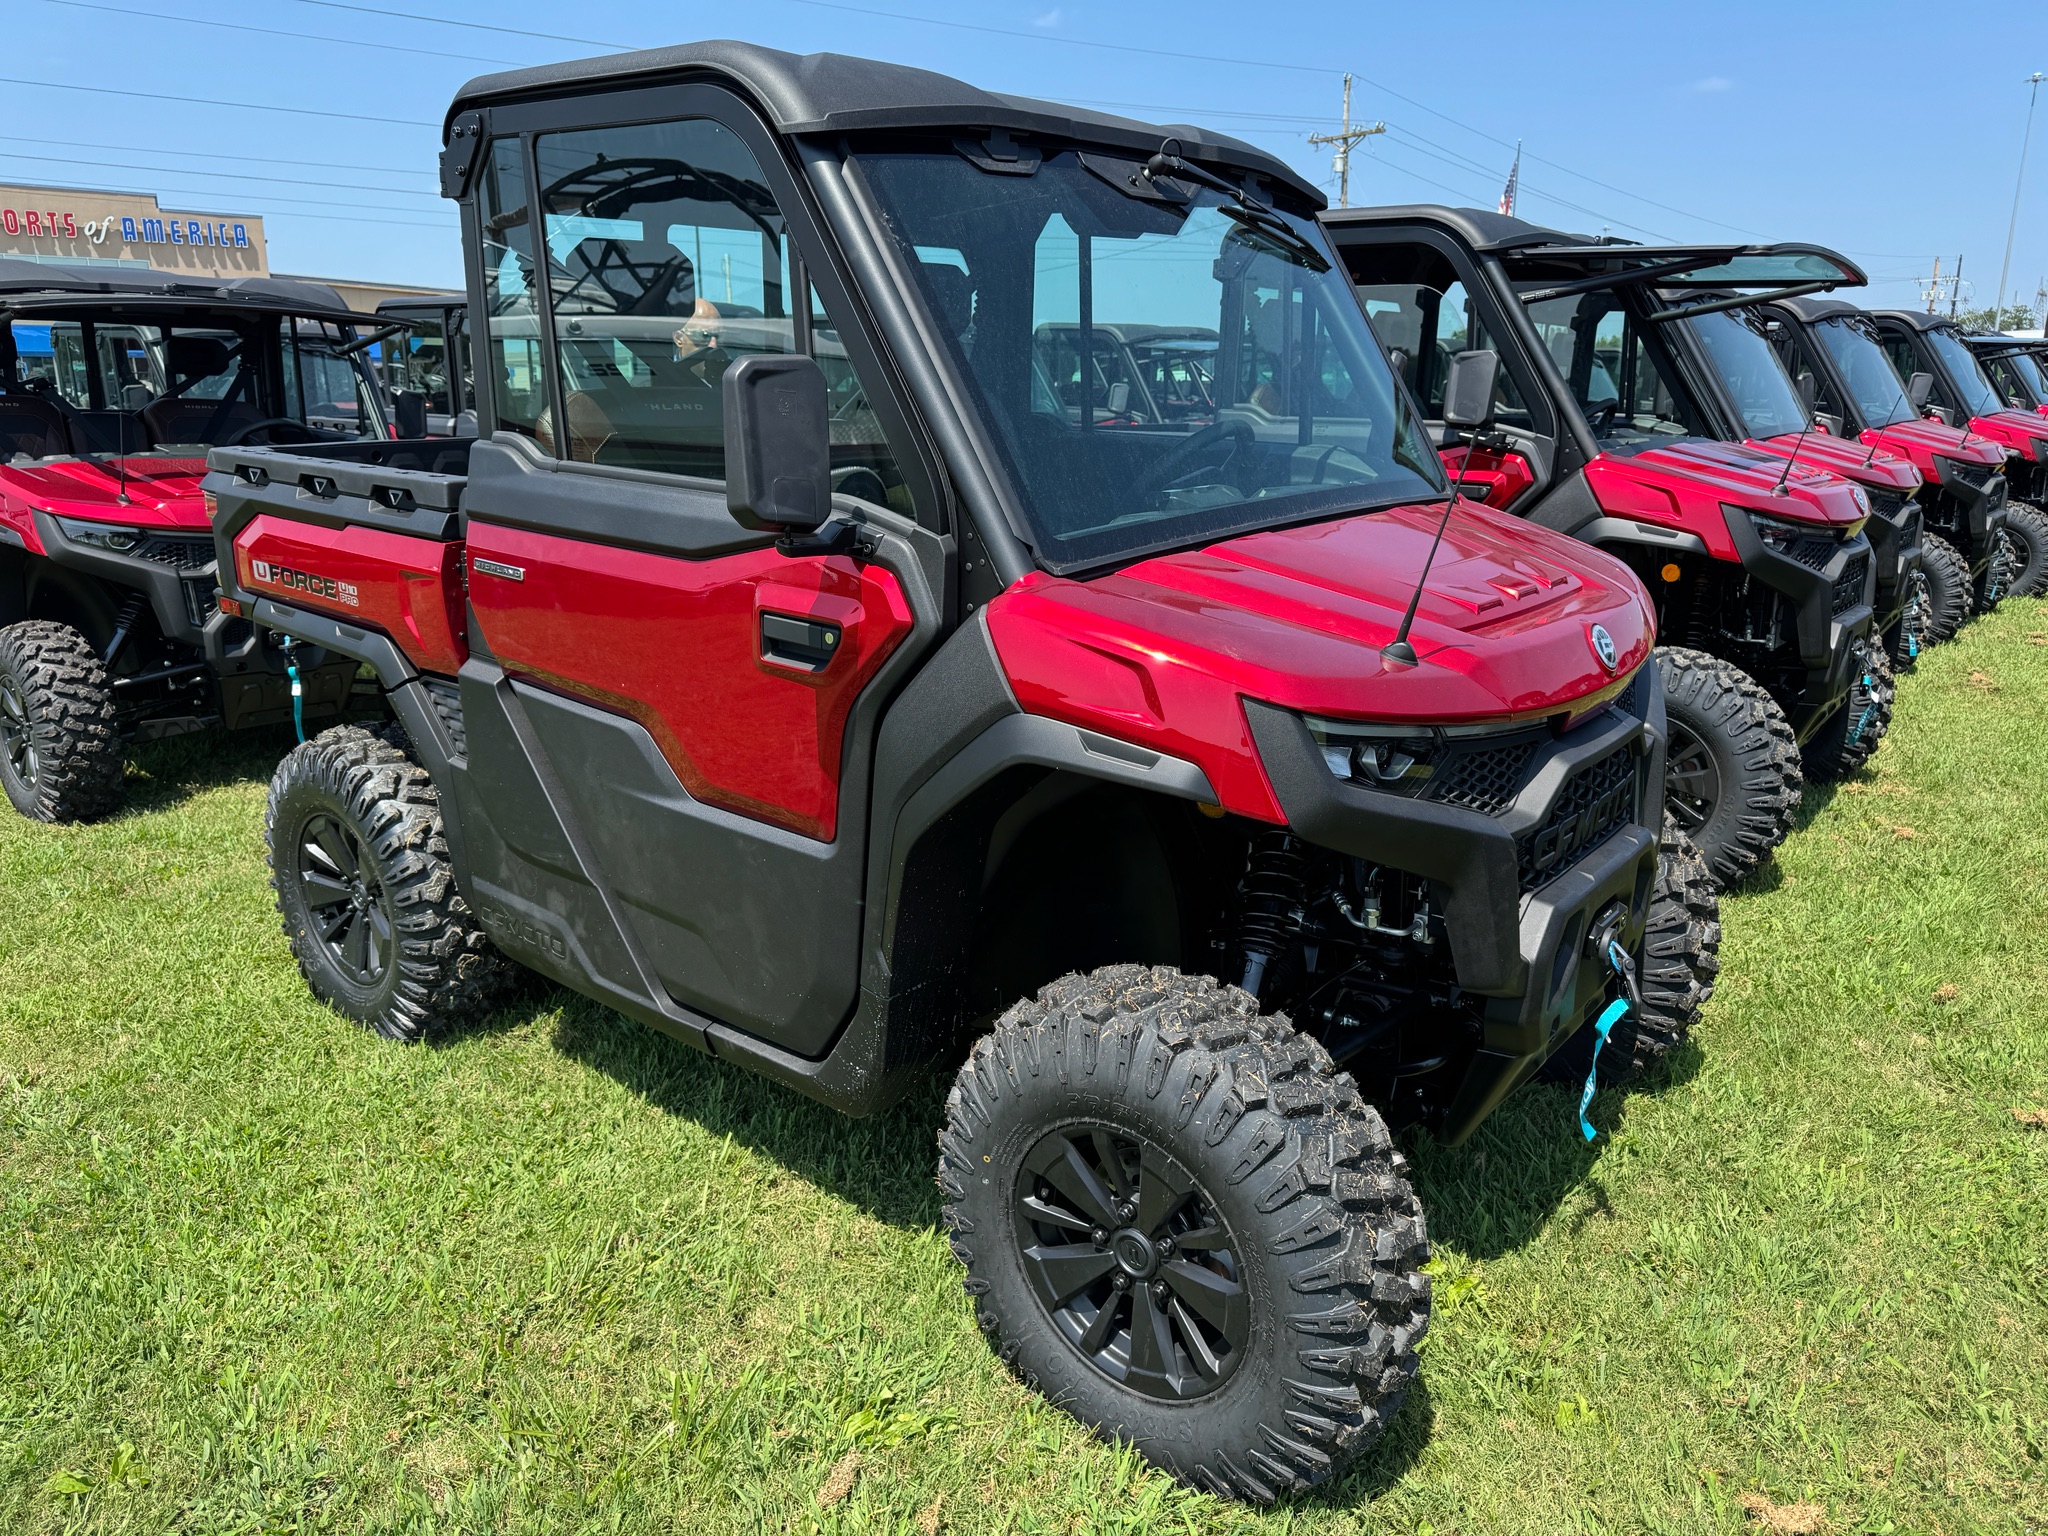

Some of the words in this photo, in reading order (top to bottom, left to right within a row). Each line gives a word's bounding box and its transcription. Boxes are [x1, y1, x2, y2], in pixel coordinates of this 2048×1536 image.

[1, 208, 78, 238] ORTS
[83, 215, 114, 244] of
[121, 216, 249, 248] AMERICA
[340, 593, 359, 607] PRO
[1534, 769, 1635, 870] CFMOTO
[480, 903, 567, 960] CFMOTO
